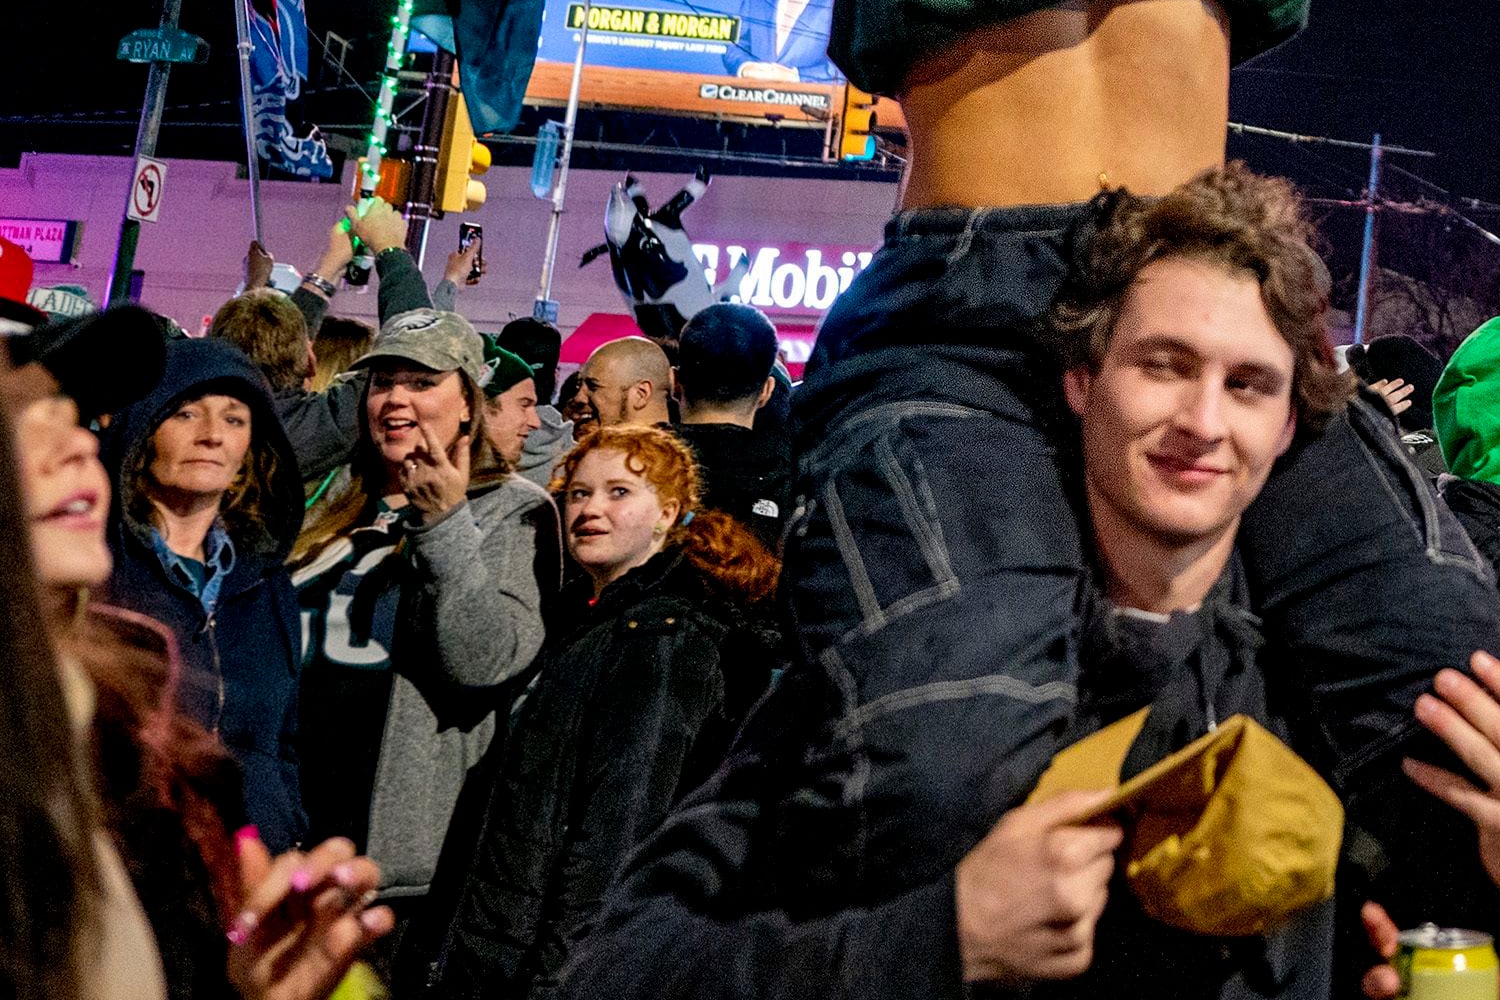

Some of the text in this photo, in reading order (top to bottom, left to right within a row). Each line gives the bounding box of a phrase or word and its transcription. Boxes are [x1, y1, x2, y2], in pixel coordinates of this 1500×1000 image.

[574, 6, 732, 40] MORGAN & MORGAN
[133, 40, 171, 59] RYAN
[0, 225, 63, 241] TTMAN PLAZA
